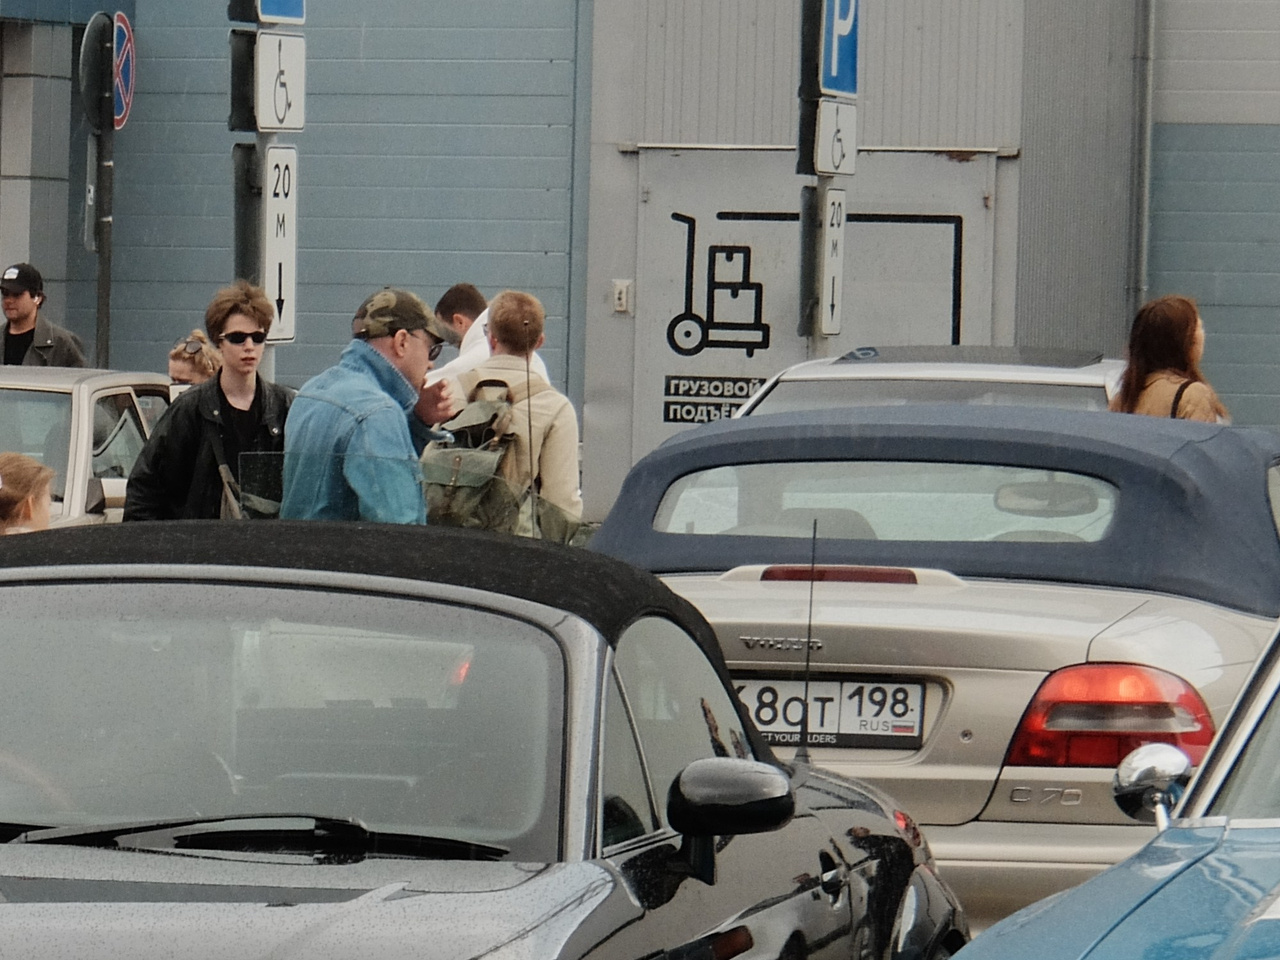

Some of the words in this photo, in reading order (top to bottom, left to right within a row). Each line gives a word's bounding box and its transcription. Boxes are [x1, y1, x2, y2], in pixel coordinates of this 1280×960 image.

[831, 0, 856, 77] P
[273, 163, 291, 199] 20
[830, 201, 842, 229] 20
[669, 379, 761, 397] ГРУЗОВОЙ
[847, 685, 910, 718] 198
[774, 733, 801, 743] YOUR
[859, 720, 890, 732] RUS
[1010, 786, 1032, 802] C
[1040, 787, 1082, 806] 70
